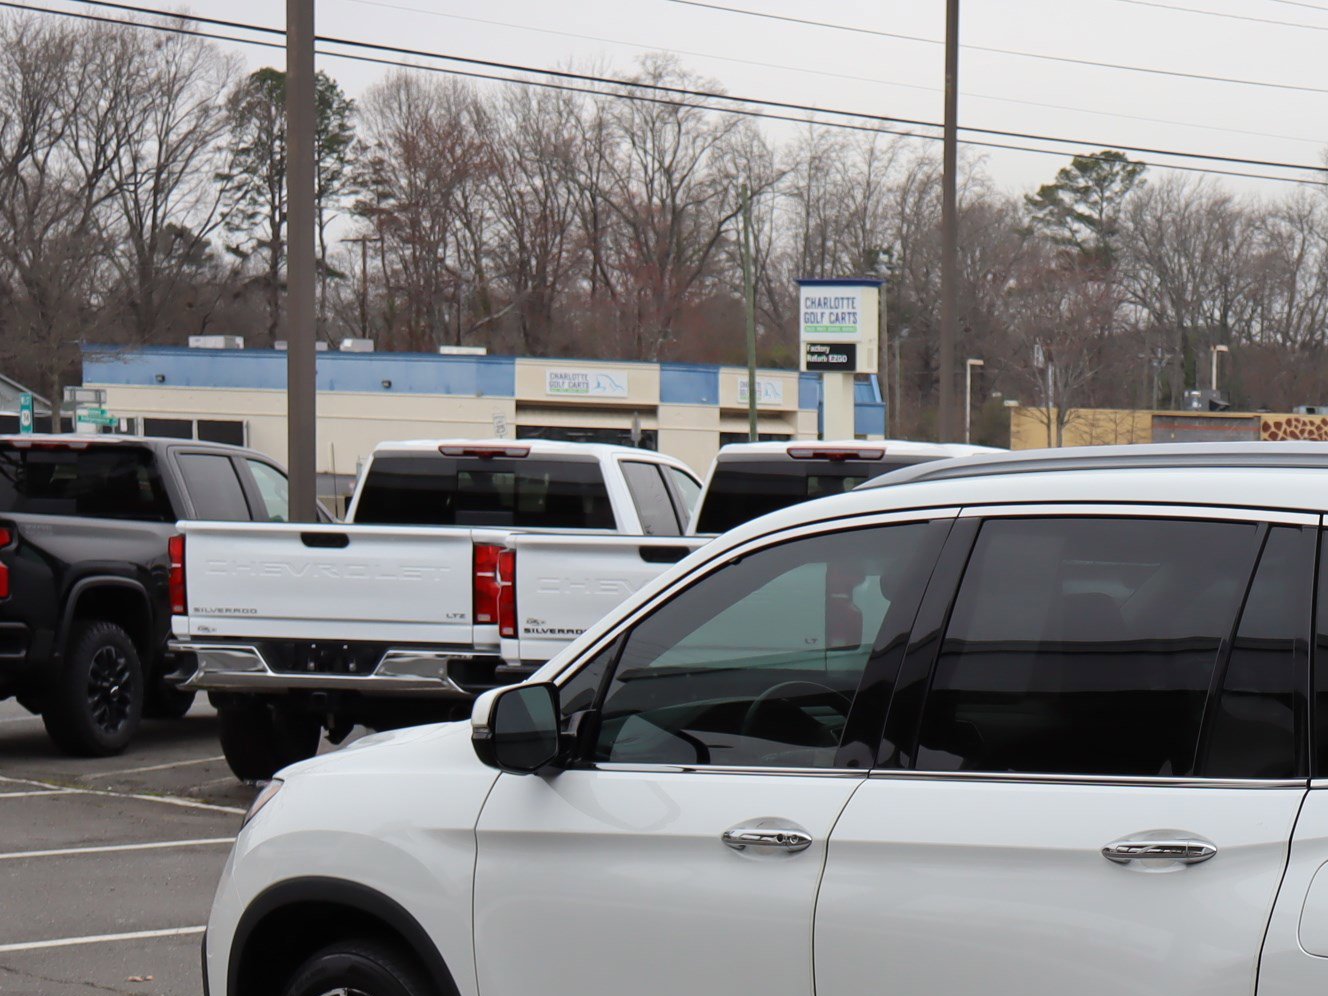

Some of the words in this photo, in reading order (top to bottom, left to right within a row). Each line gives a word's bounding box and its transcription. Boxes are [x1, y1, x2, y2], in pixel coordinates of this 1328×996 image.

[804, 296, 857, 309] CHARLOTTE
[803, 312, 826, 324] GOLF
[829, 312, 858, 324] CARTS
[549, 372, 588, 381] CHARLOTTE
[549, 381, 566, 389] GOLF
[204, 559, 451, 580] CHEVROLET
